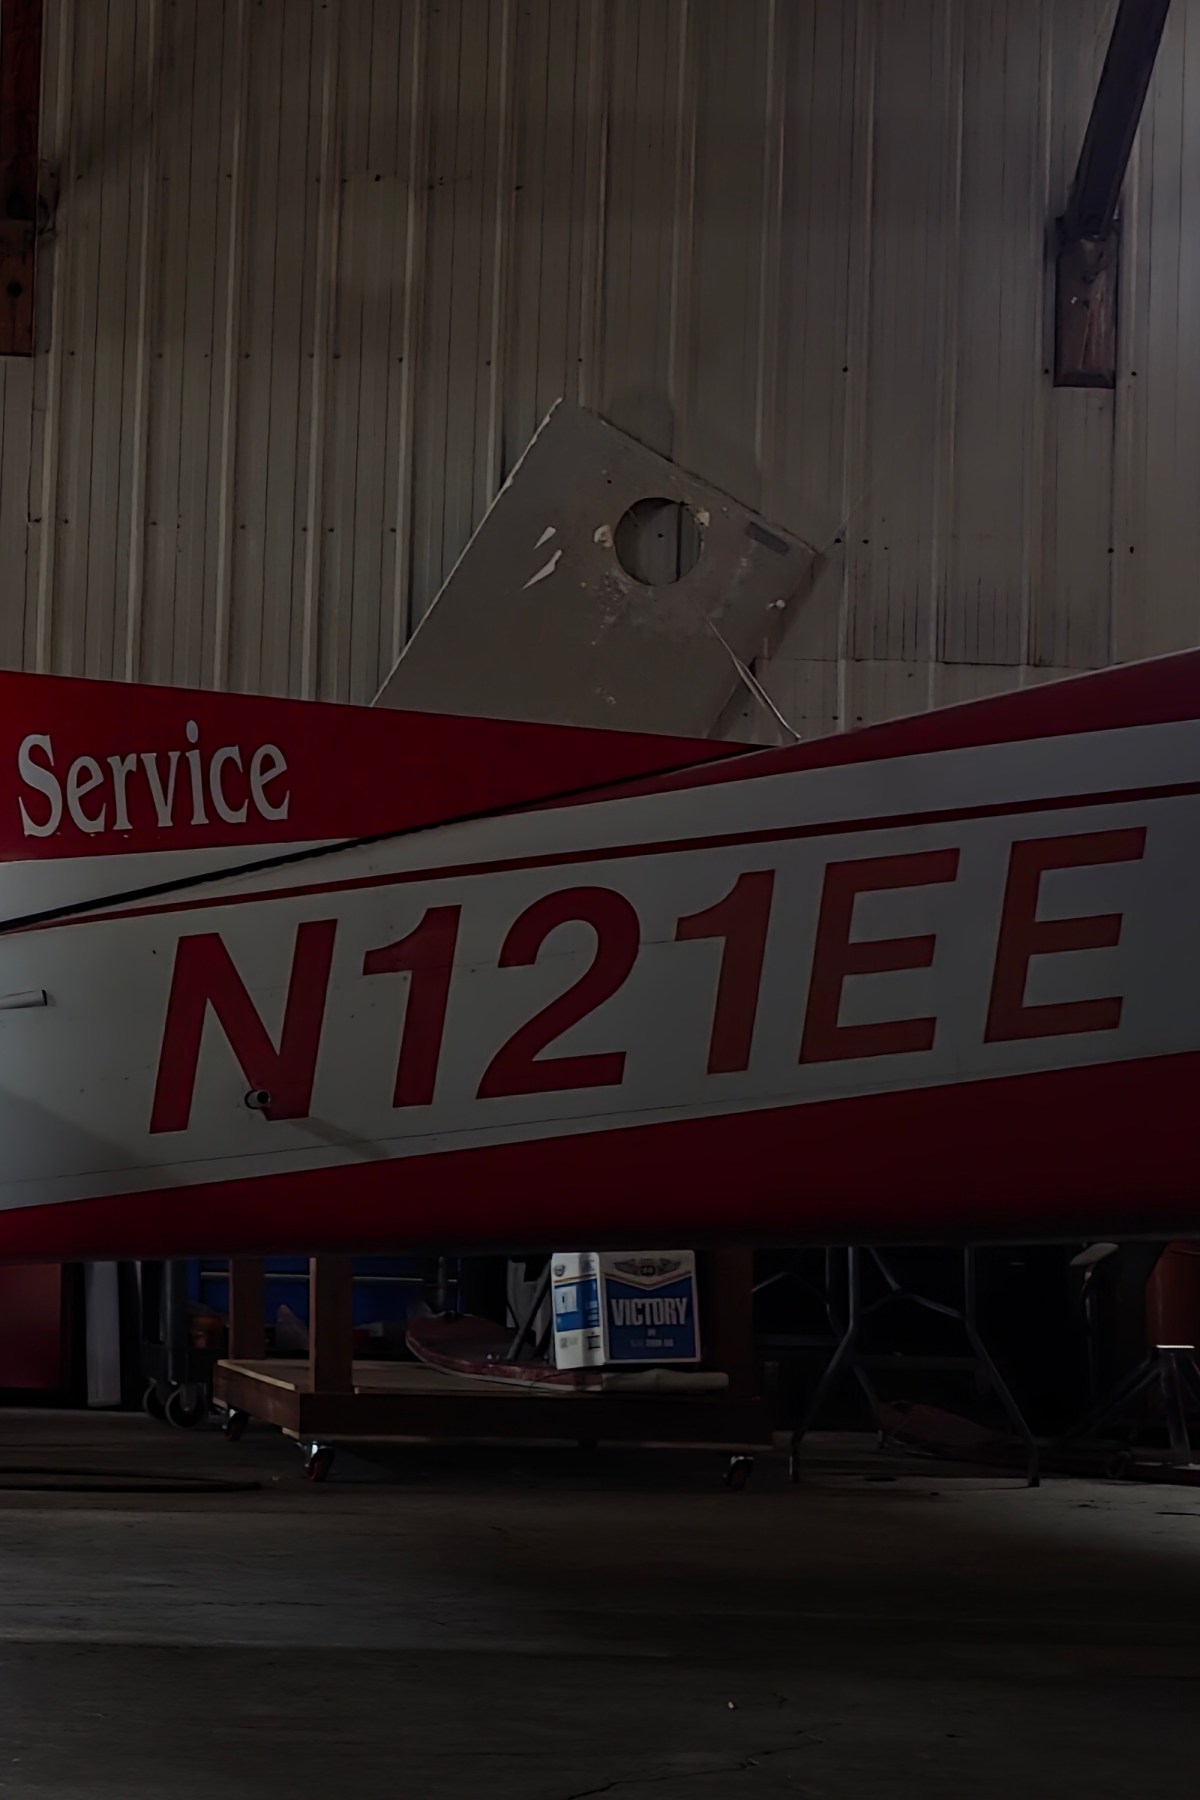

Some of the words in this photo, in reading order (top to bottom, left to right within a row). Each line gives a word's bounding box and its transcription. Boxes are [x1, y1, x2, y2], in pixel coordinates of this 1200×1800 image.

[17, 719, 290, 838] Service
[149, 826, 1148, 1134] N121EE
[609, 1297, 689, 1327] VICTORY
